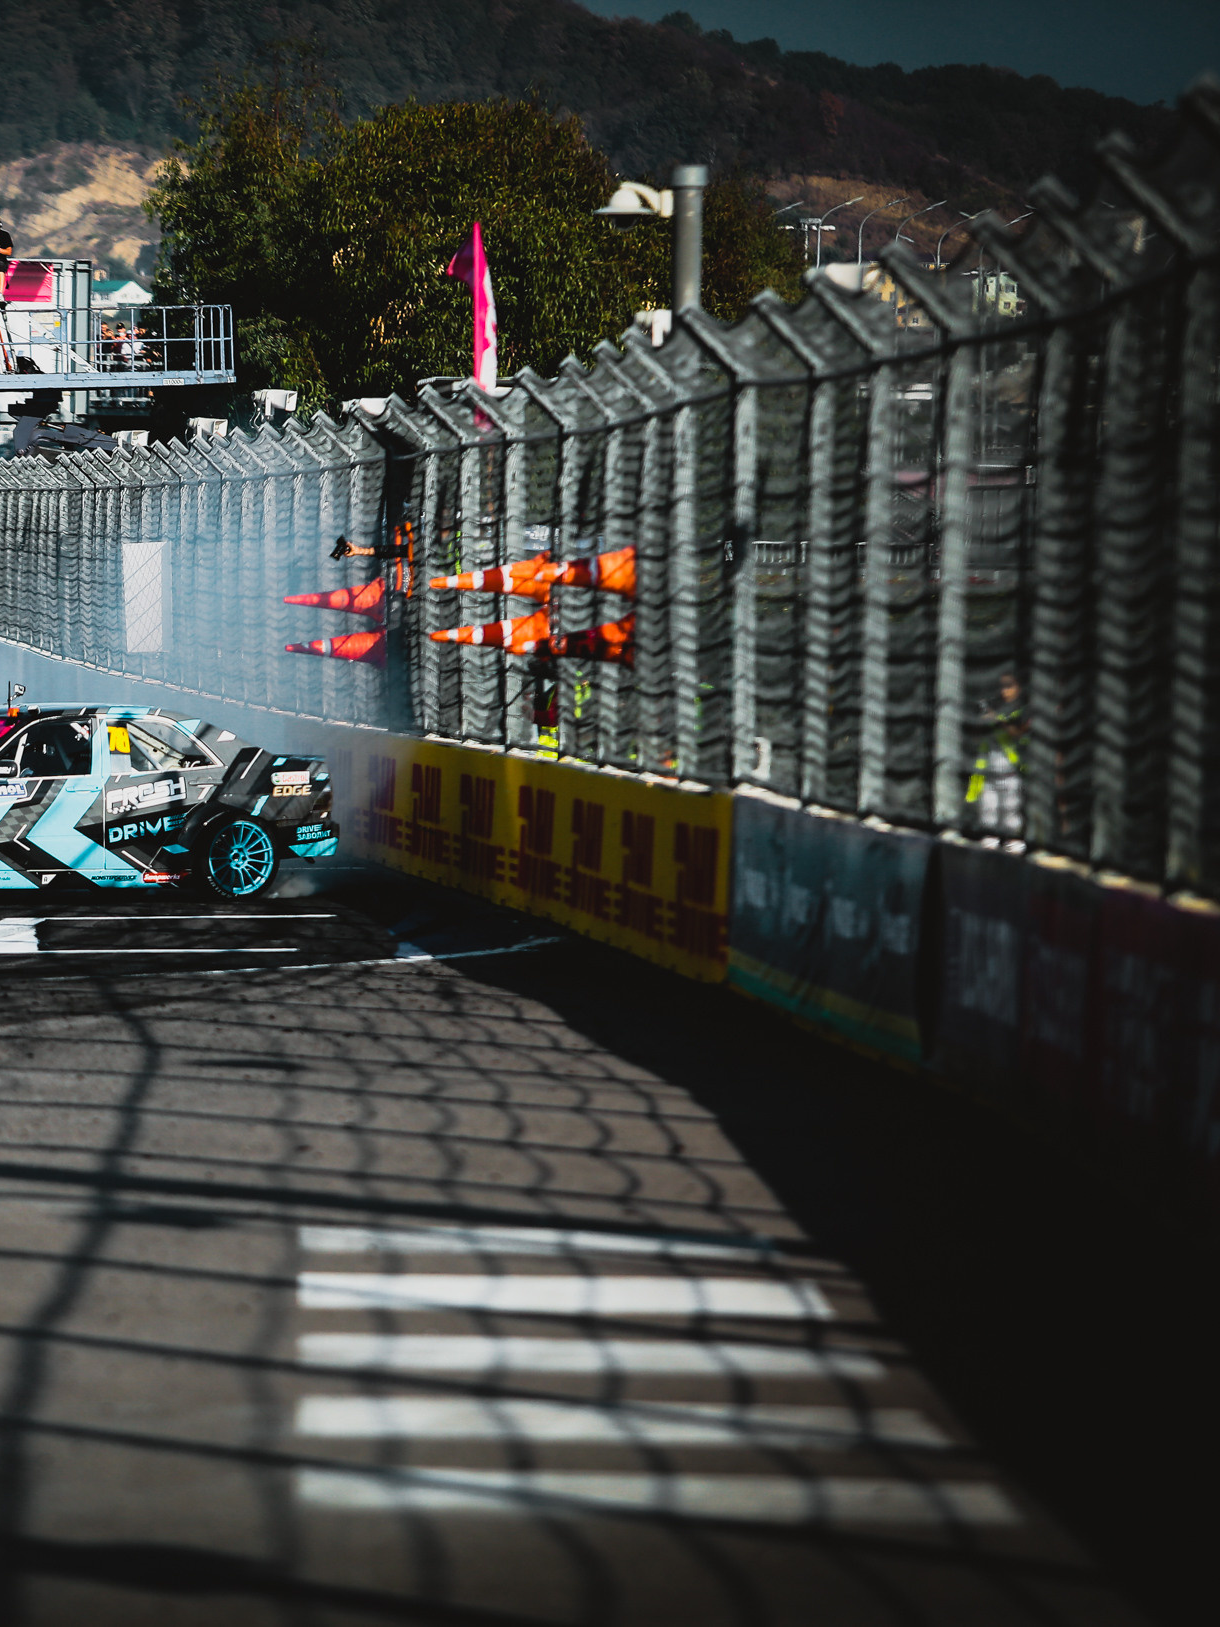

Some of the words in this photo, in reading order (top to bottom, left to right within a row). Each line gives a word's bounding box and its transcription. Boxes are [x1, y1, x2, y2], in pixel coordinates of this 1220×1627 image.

[107, 726, 131, 754] 78
[106, 776, 187, 815] FRESH
[272, 784, 313, 797] EDGE
[108, 813, 185, 843] DRIVE
